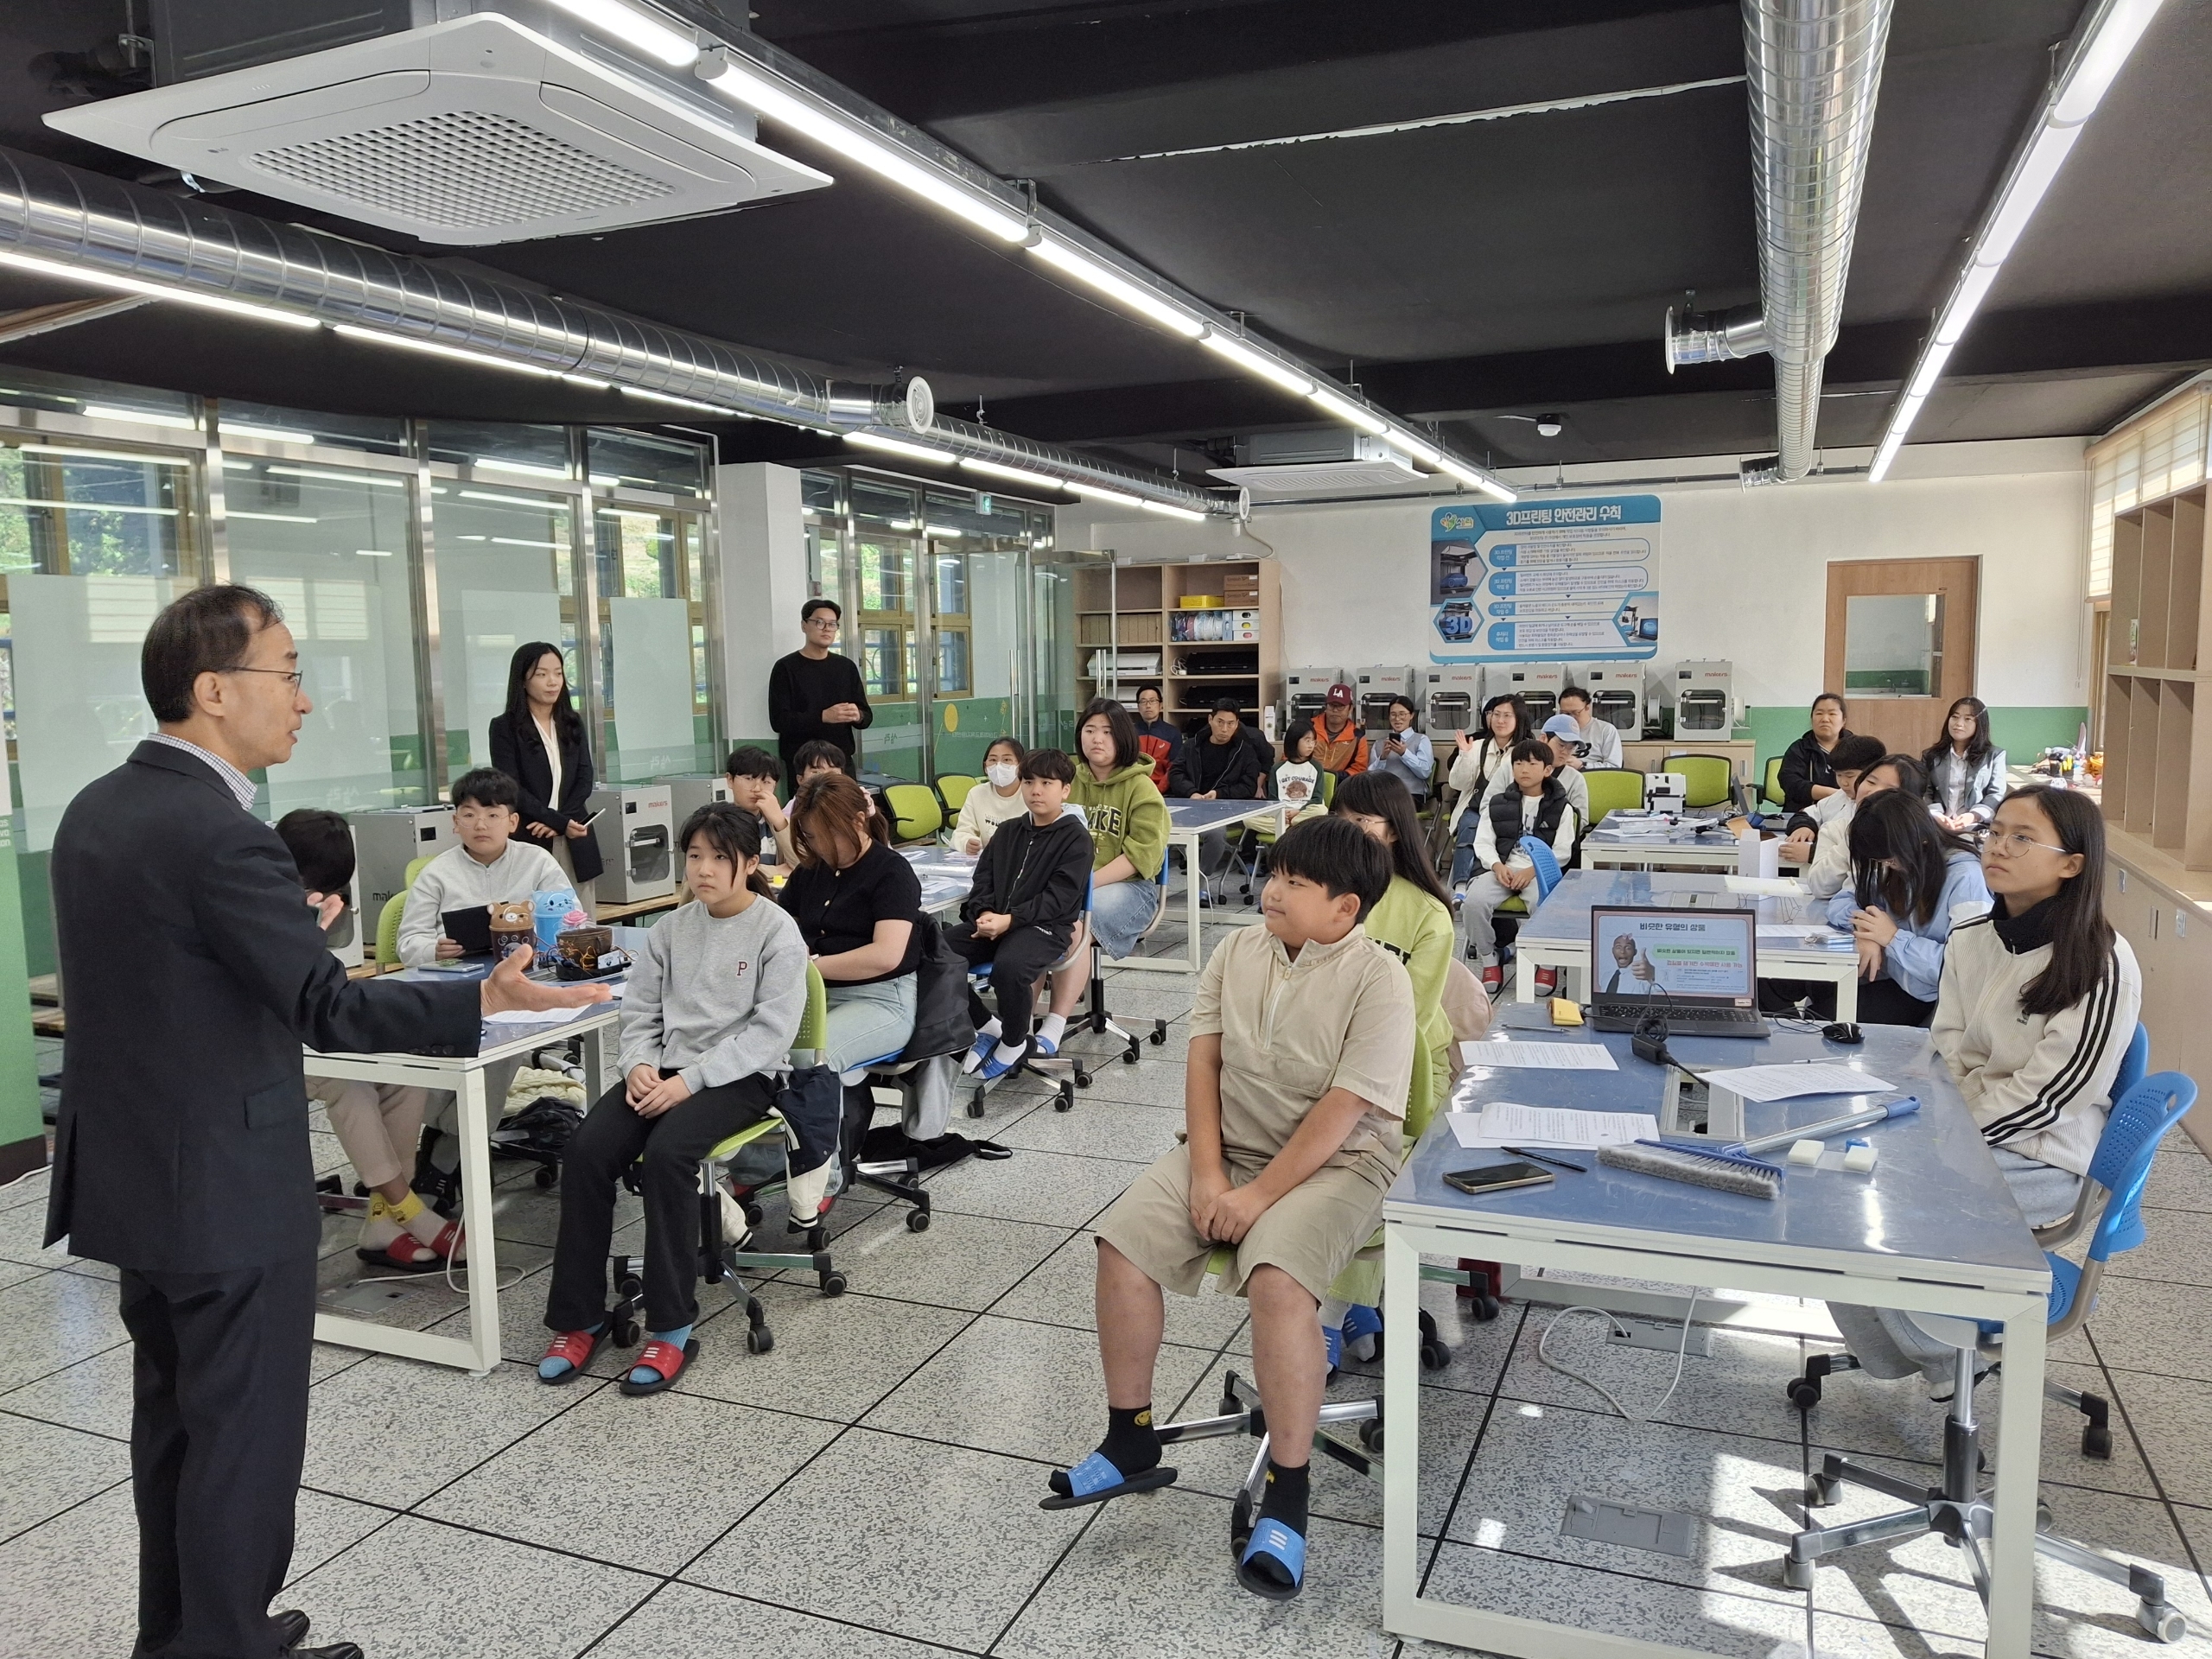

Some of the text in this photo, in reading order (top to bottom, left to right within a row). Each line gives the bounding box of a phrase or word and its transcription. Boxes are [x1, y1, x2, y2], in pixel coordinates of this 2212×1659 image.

[1506, 505, 1622, 525] 3D프린팅 안전관리 수칙
[1446, 616, 1472, 634] 3D
[1332, 688, 1344, 698] LA
[1640, 922, 1663, 931] 비슷한
[736, 960, 748, 976] P
